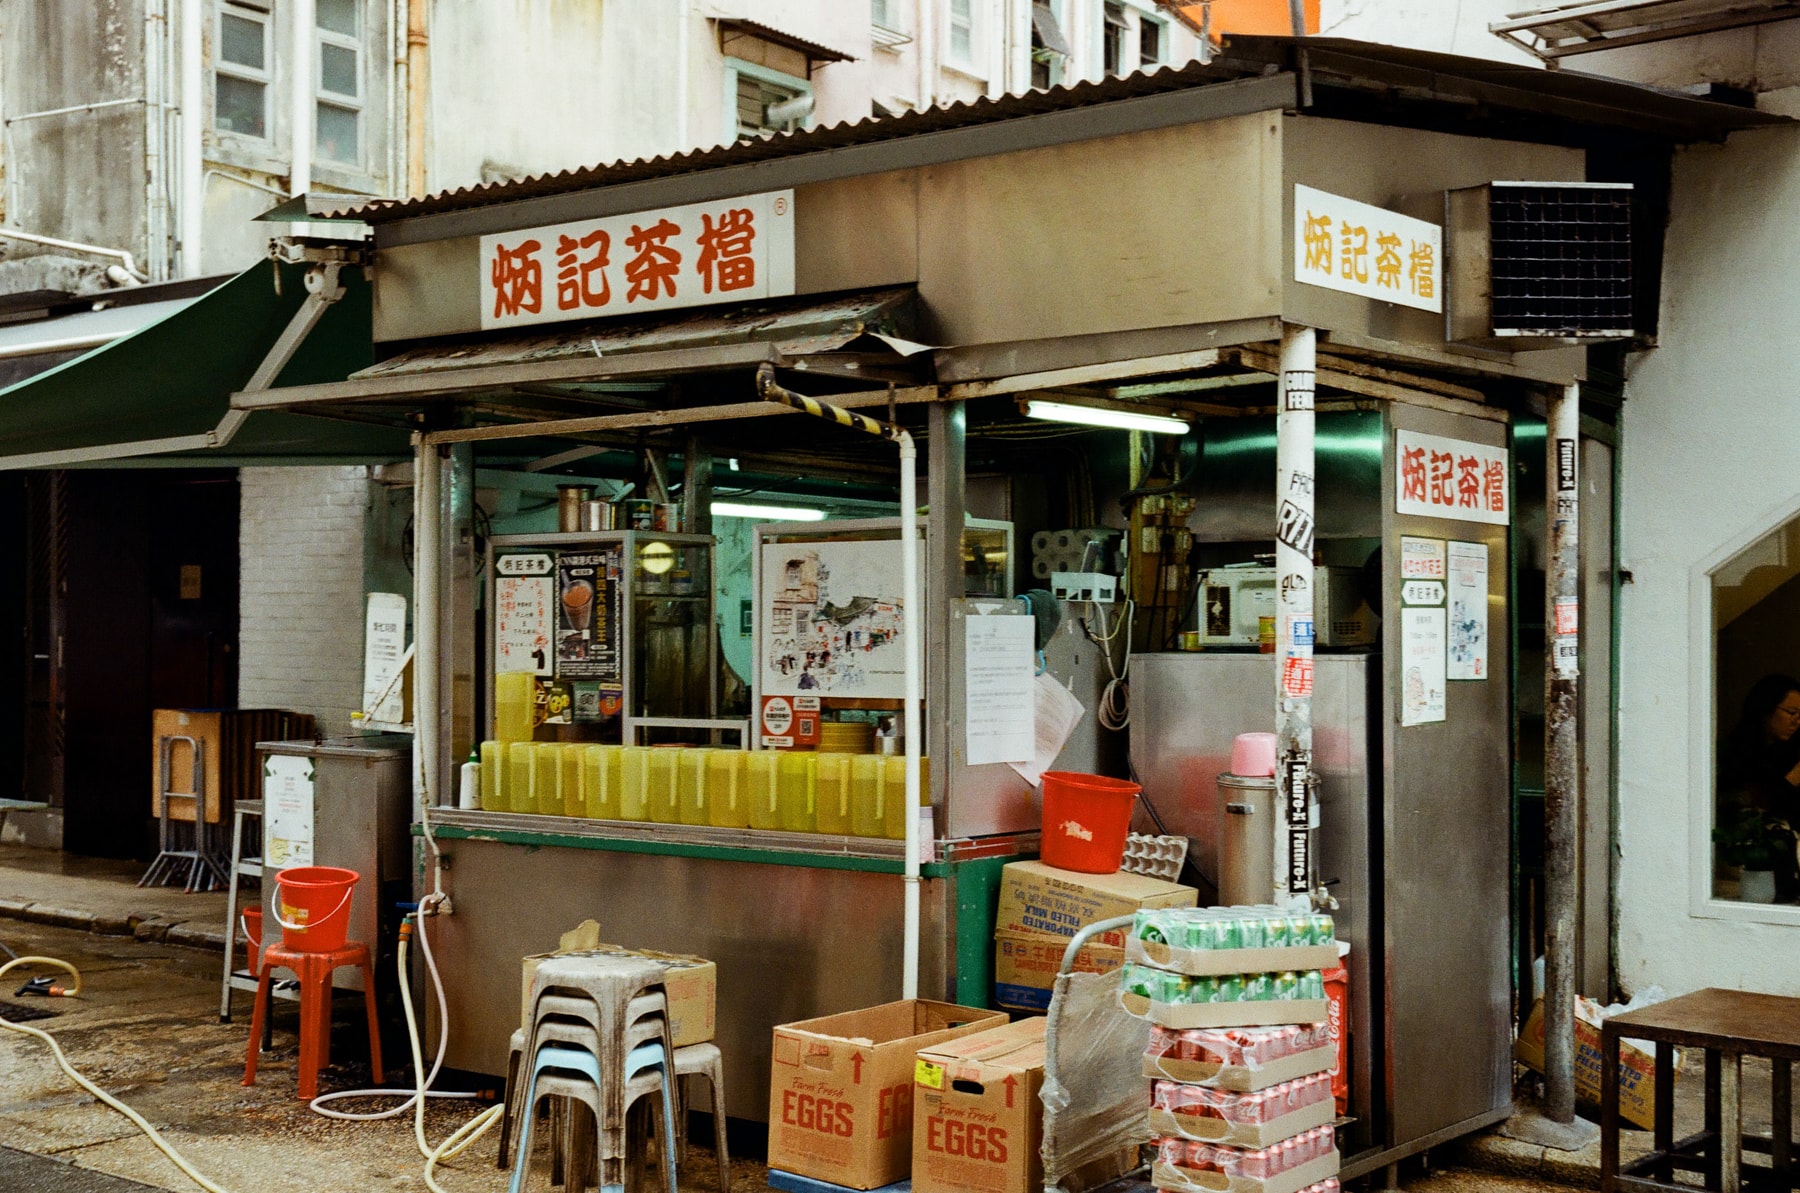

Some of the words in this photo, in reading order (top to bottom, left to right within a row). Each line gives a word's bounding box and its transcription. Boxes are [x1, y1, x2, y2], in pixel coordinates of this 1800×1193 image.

[491, 208, 756, 319] 炳記茶檔
[1304, 210, 1434, 299] 炳記茶檔
[1401, 444, 1504, 513] 炳記茶檔
[1291, 764, 1308, 822] Future-X
[1292, 832, 1308, 890] Future-X
[1024, 903, 1048, 918] MILK
[1051, 911, 1080, 927] FILLED
[792, 1076, 816, 1095] Farm
[817, 1082, 844, 1099] Fresh
[938, 1102, 966, 1118] Farm
[782, 1089, 854, 1138] EGGS
[927, 1115, 1008, 1164] EGGS
